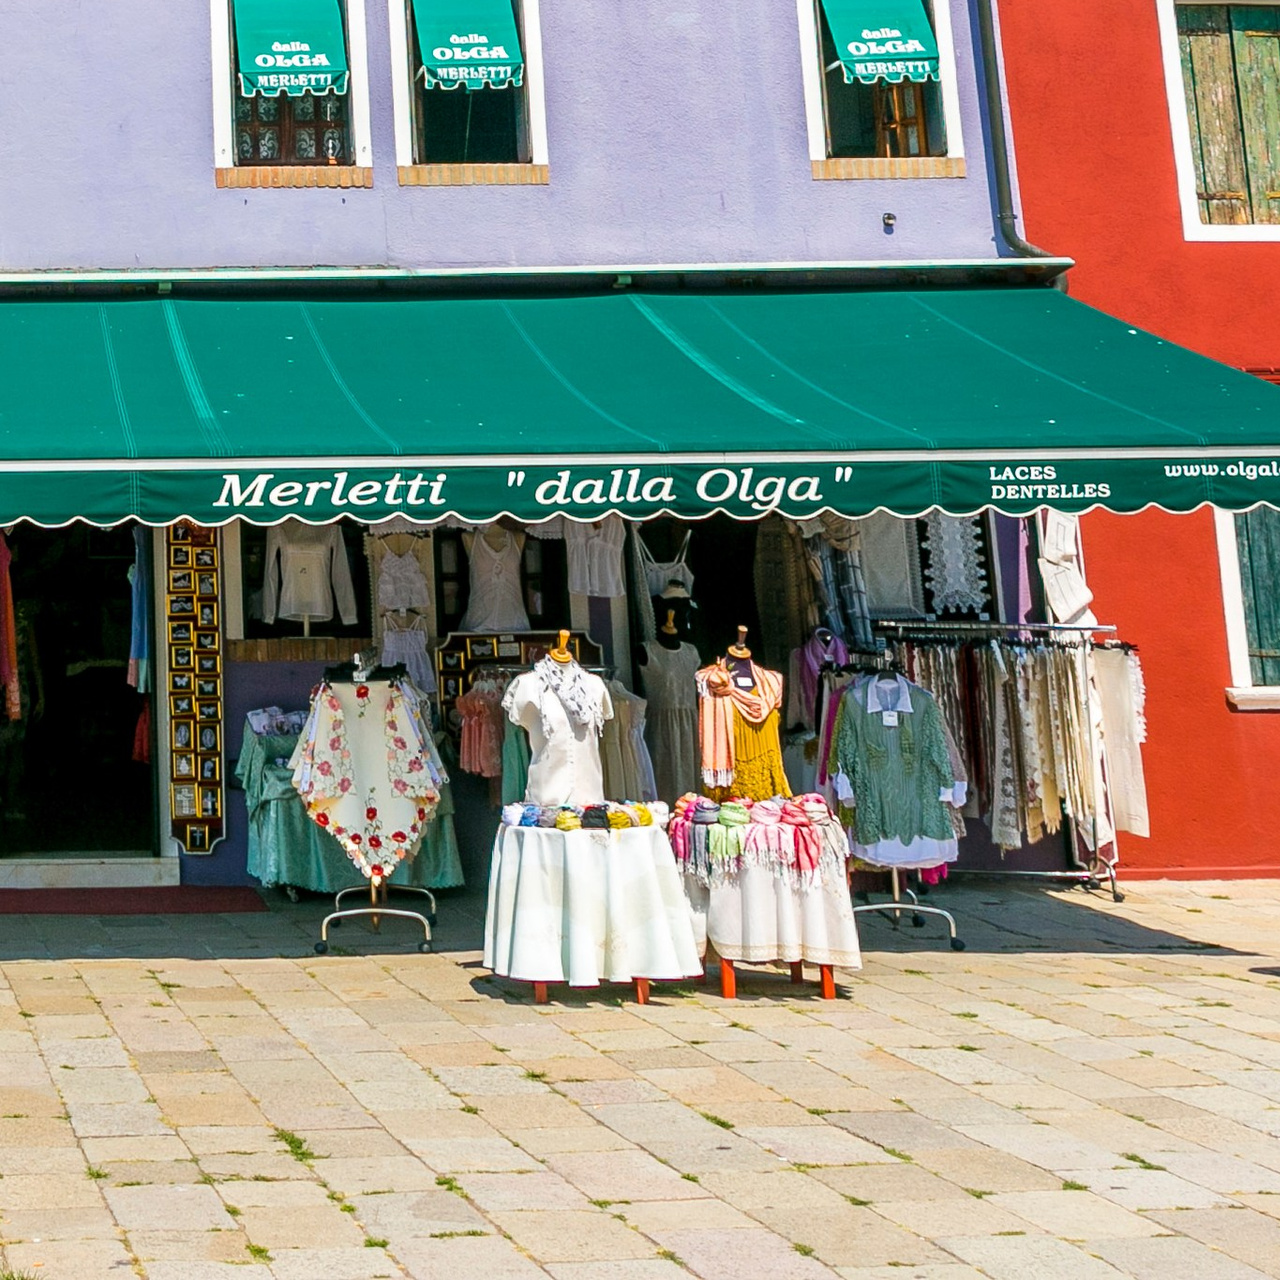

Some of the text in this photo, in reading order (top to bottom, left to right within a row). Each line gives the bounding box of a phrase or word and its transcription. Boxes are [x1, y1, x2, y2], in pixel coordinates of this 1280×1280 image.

[449, 33, 489, 44] dalla
[862, 28, 902, 39] dalla
[271, 41, 311, 52] dalla
[432, 45, 509, 60] OLGA
[847, 39, 926, 56] OLGA
[254, 53, 331, 67] OLGA
[437, 66, 511, 80] MERLETTI
[854, 61, 931, 74] MERLETTI
[257, 74, 331, 87] MERLETTI
[989, 465, 1057, 480] LACES
[1163, 460, 1280, 480] www.olgal
[212, 471, 447, 507] Merletti
[991, 483, 1111, 500] DENTELLES
